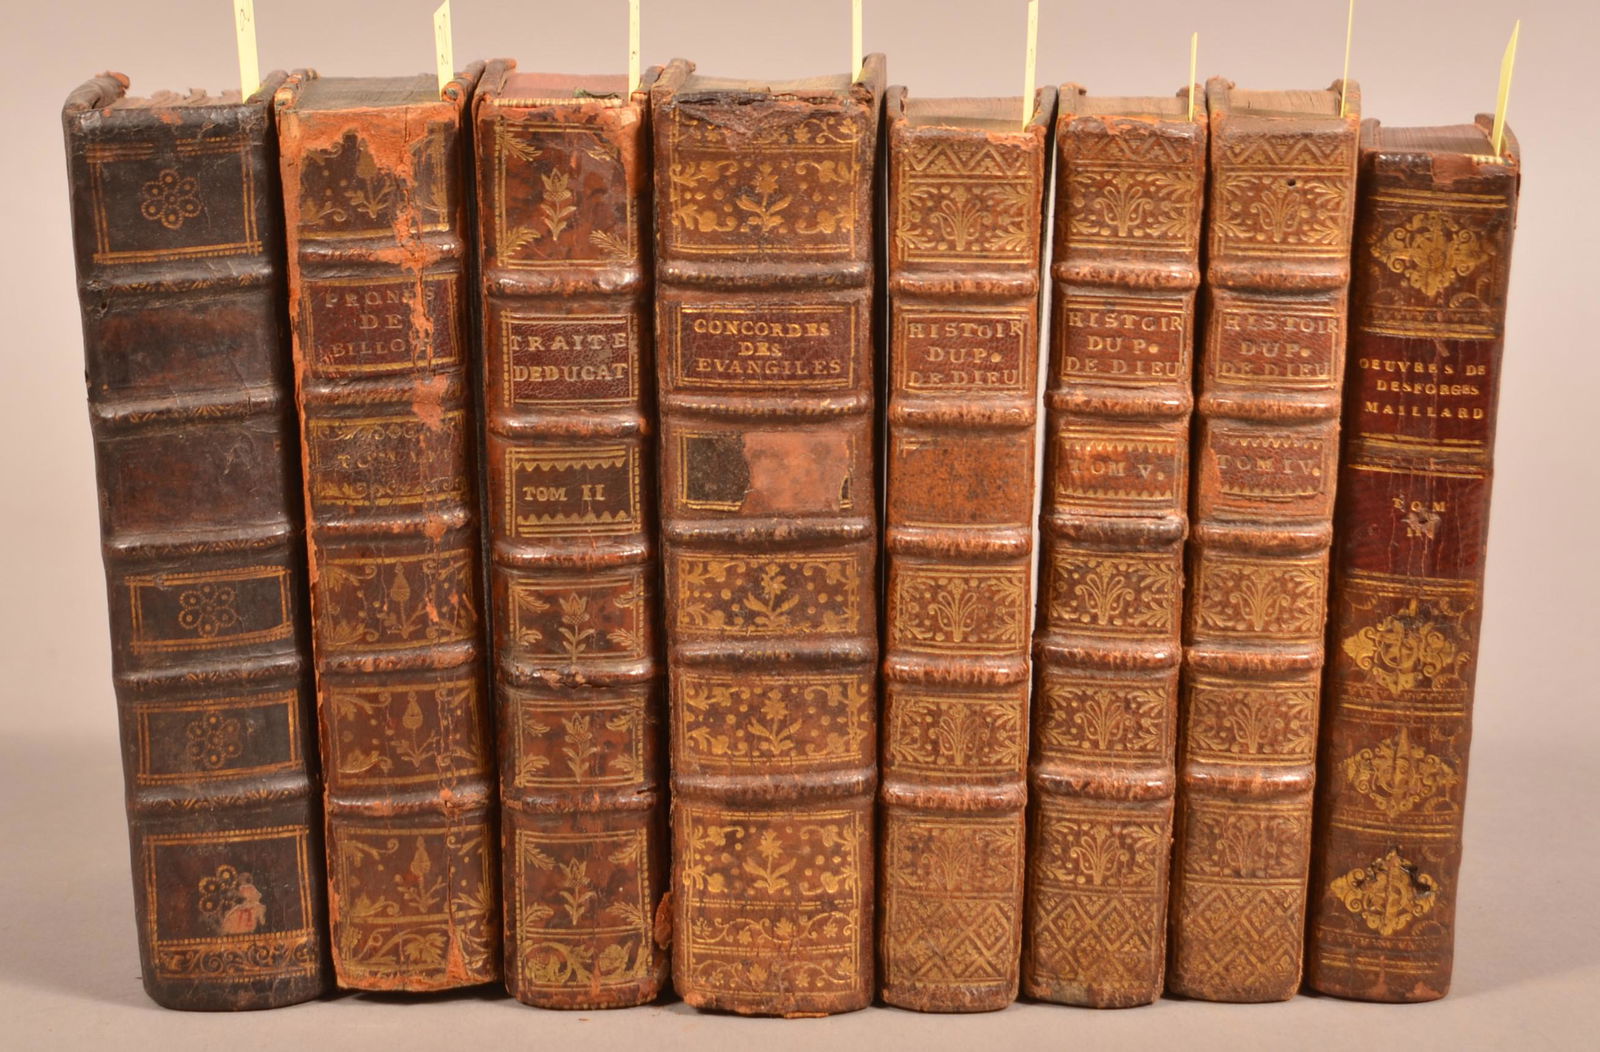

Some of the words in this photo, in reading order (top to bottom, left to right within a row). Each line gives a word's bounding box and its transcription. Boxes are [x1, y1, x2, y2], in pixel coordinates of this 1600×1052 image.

[359, 314, 403, 329] DE
[693, 318, 831, 337] CONCORDES
[908, 320, 1023, 338] HISTOIR
[1067, 311, 1183, 331] HISTOIR
[1223, 314, 1339, 333] HISTOIR
[510, 332, 627, 351] TRAITE
[738, 341, 783, 357] DES
[695, 357, 842, 375] EVANGILES
[1065, 356, 1098, 372] DE
[1110, 359, 1181, 377] DIEU
[1359, 358, 1455, 375] OEUVRES
[1465, 364, 1487, 376] DE
[950, 369, 1019, 386] DIEU
[1376, 379, 1481, 396] DESFORGES
[1364, 401, 1485, 419] MAILLARD
[1070, 459, 1126, 477] TOM
[522, 486, 568, 502] TOM
[581, 484, 606, 501] II
